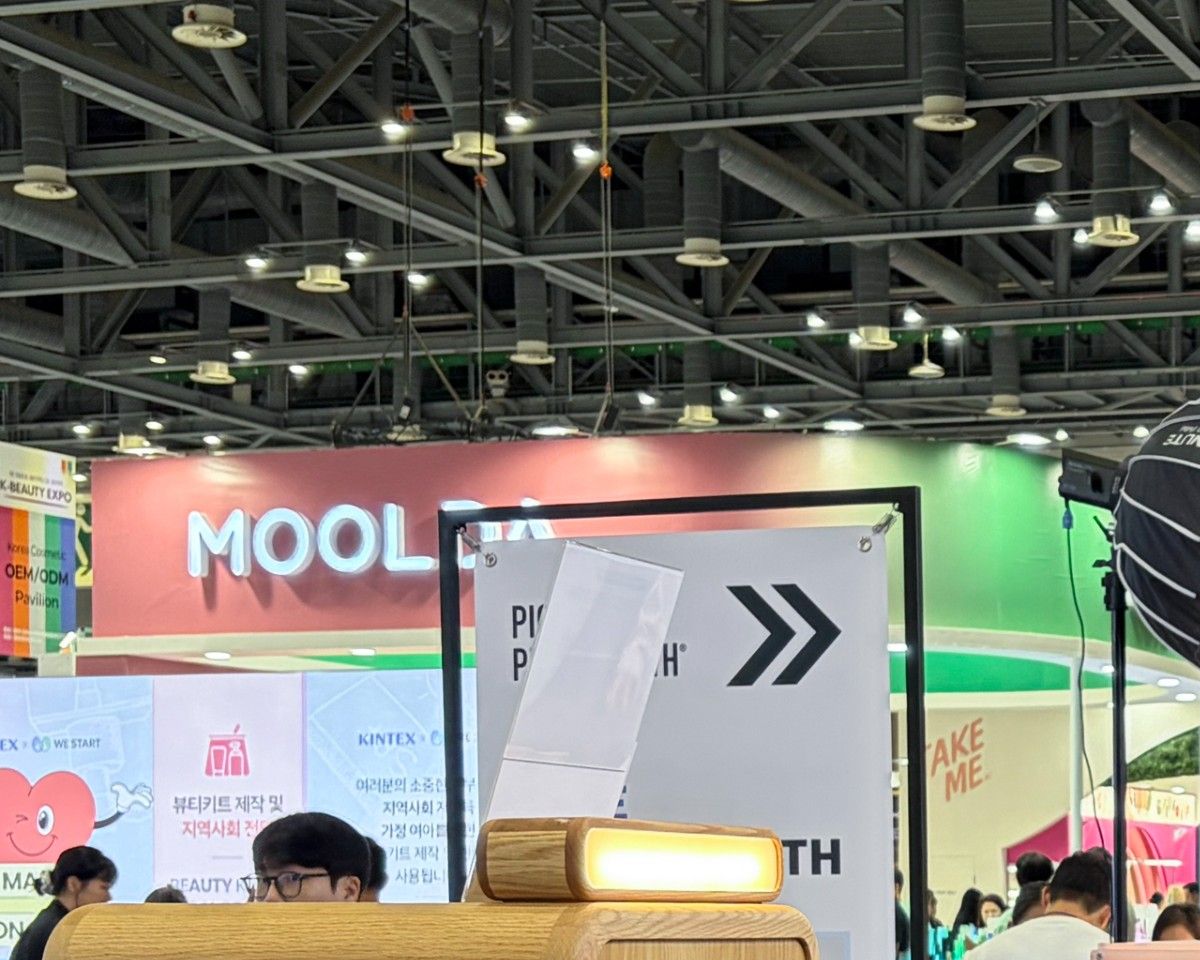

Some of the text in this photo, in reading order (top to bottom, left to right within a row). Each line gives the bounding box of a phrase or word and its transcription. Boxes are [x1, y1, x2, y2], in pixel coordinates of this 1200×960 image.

[47, 488, 72, 503] EXPO
[5, 563, 69, 587] OEM/ODM
[15, 590, 60, 609] Pavilion
[71, 738, 101, 749] START
[358, 732, 416, 746] KINTEX
[926, 717, 984, 778] AKE
[356, 777, 407, 793] 여러분의
[173, 794, 283, 814] 뷰티키트 제작 및
[383, 801, 433, 815] 지역사회
[182, 819, 240, 838] 지역사회
